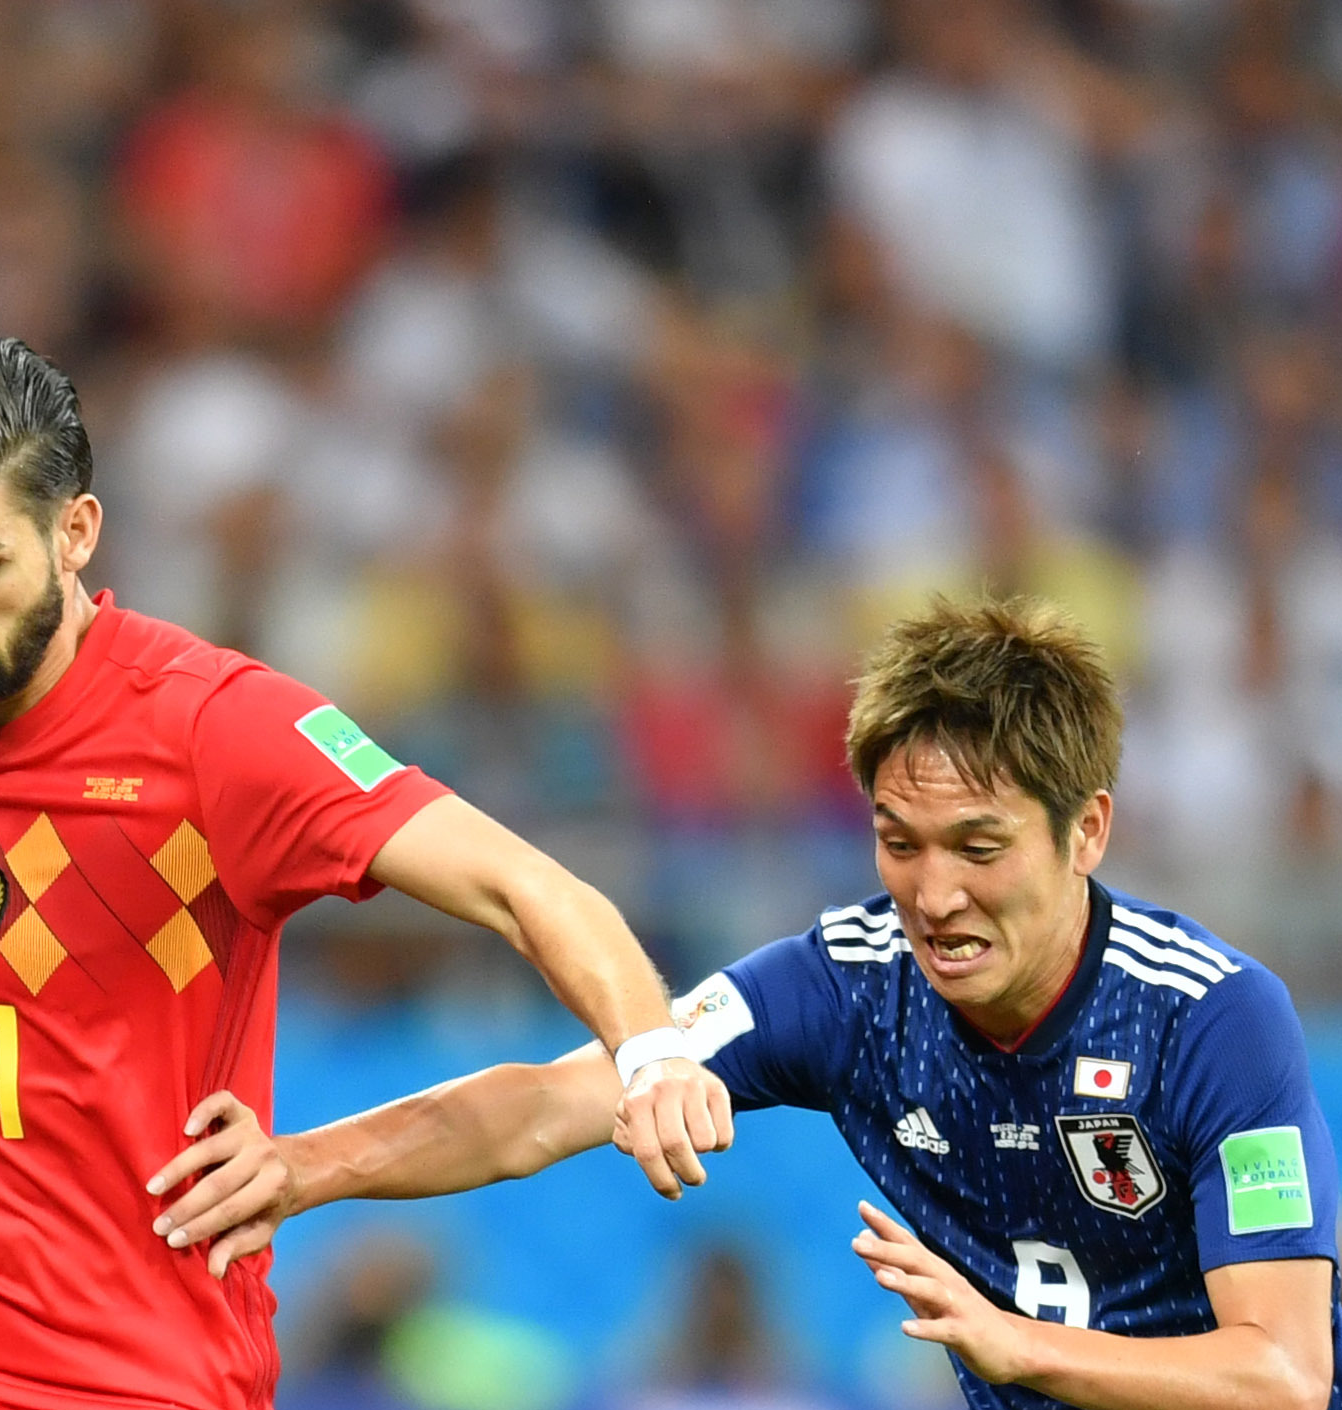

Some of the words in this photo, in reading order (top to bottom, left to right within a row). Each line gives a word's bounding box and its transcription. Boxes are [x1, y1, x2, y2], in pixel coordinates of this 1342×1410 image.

[1077, 1118, 1121, 1131] JAPAN
[1230, 1157, 1300, 1176] LIVING
[1277, 1188, 1304, 1200] FIFA
[1012, 1240, 1091, 1330] 8
